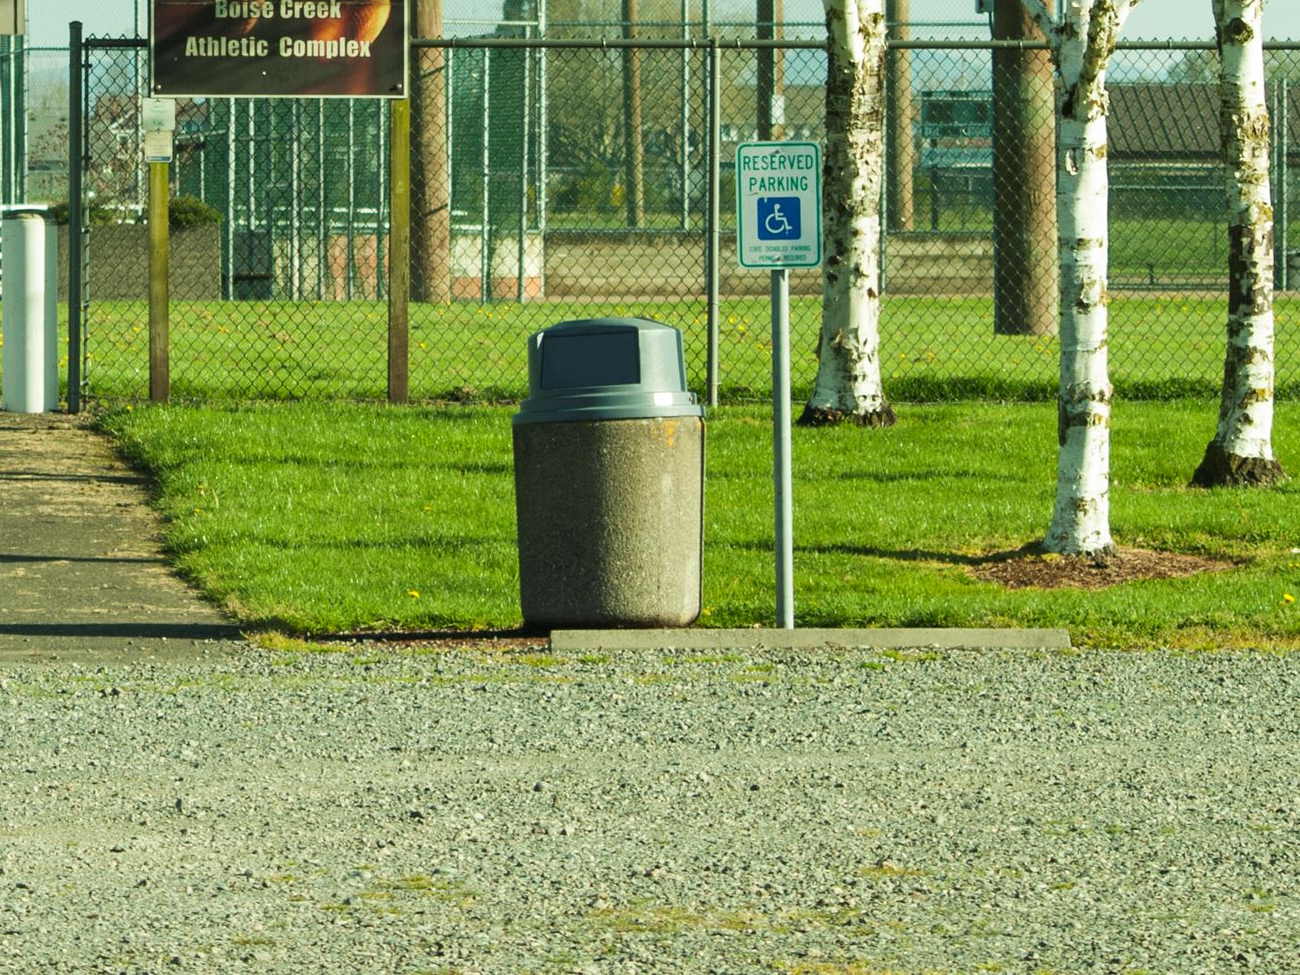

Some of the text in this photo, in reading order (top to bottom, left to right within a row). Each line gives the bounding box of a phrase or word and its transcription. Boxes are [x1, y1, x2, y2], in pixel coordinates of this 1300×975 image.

[185, 36, 371, 59] Athletic Complex
[743, 154, 814, 171] RESERVED
[749, 176, 809, 192] PARKING
